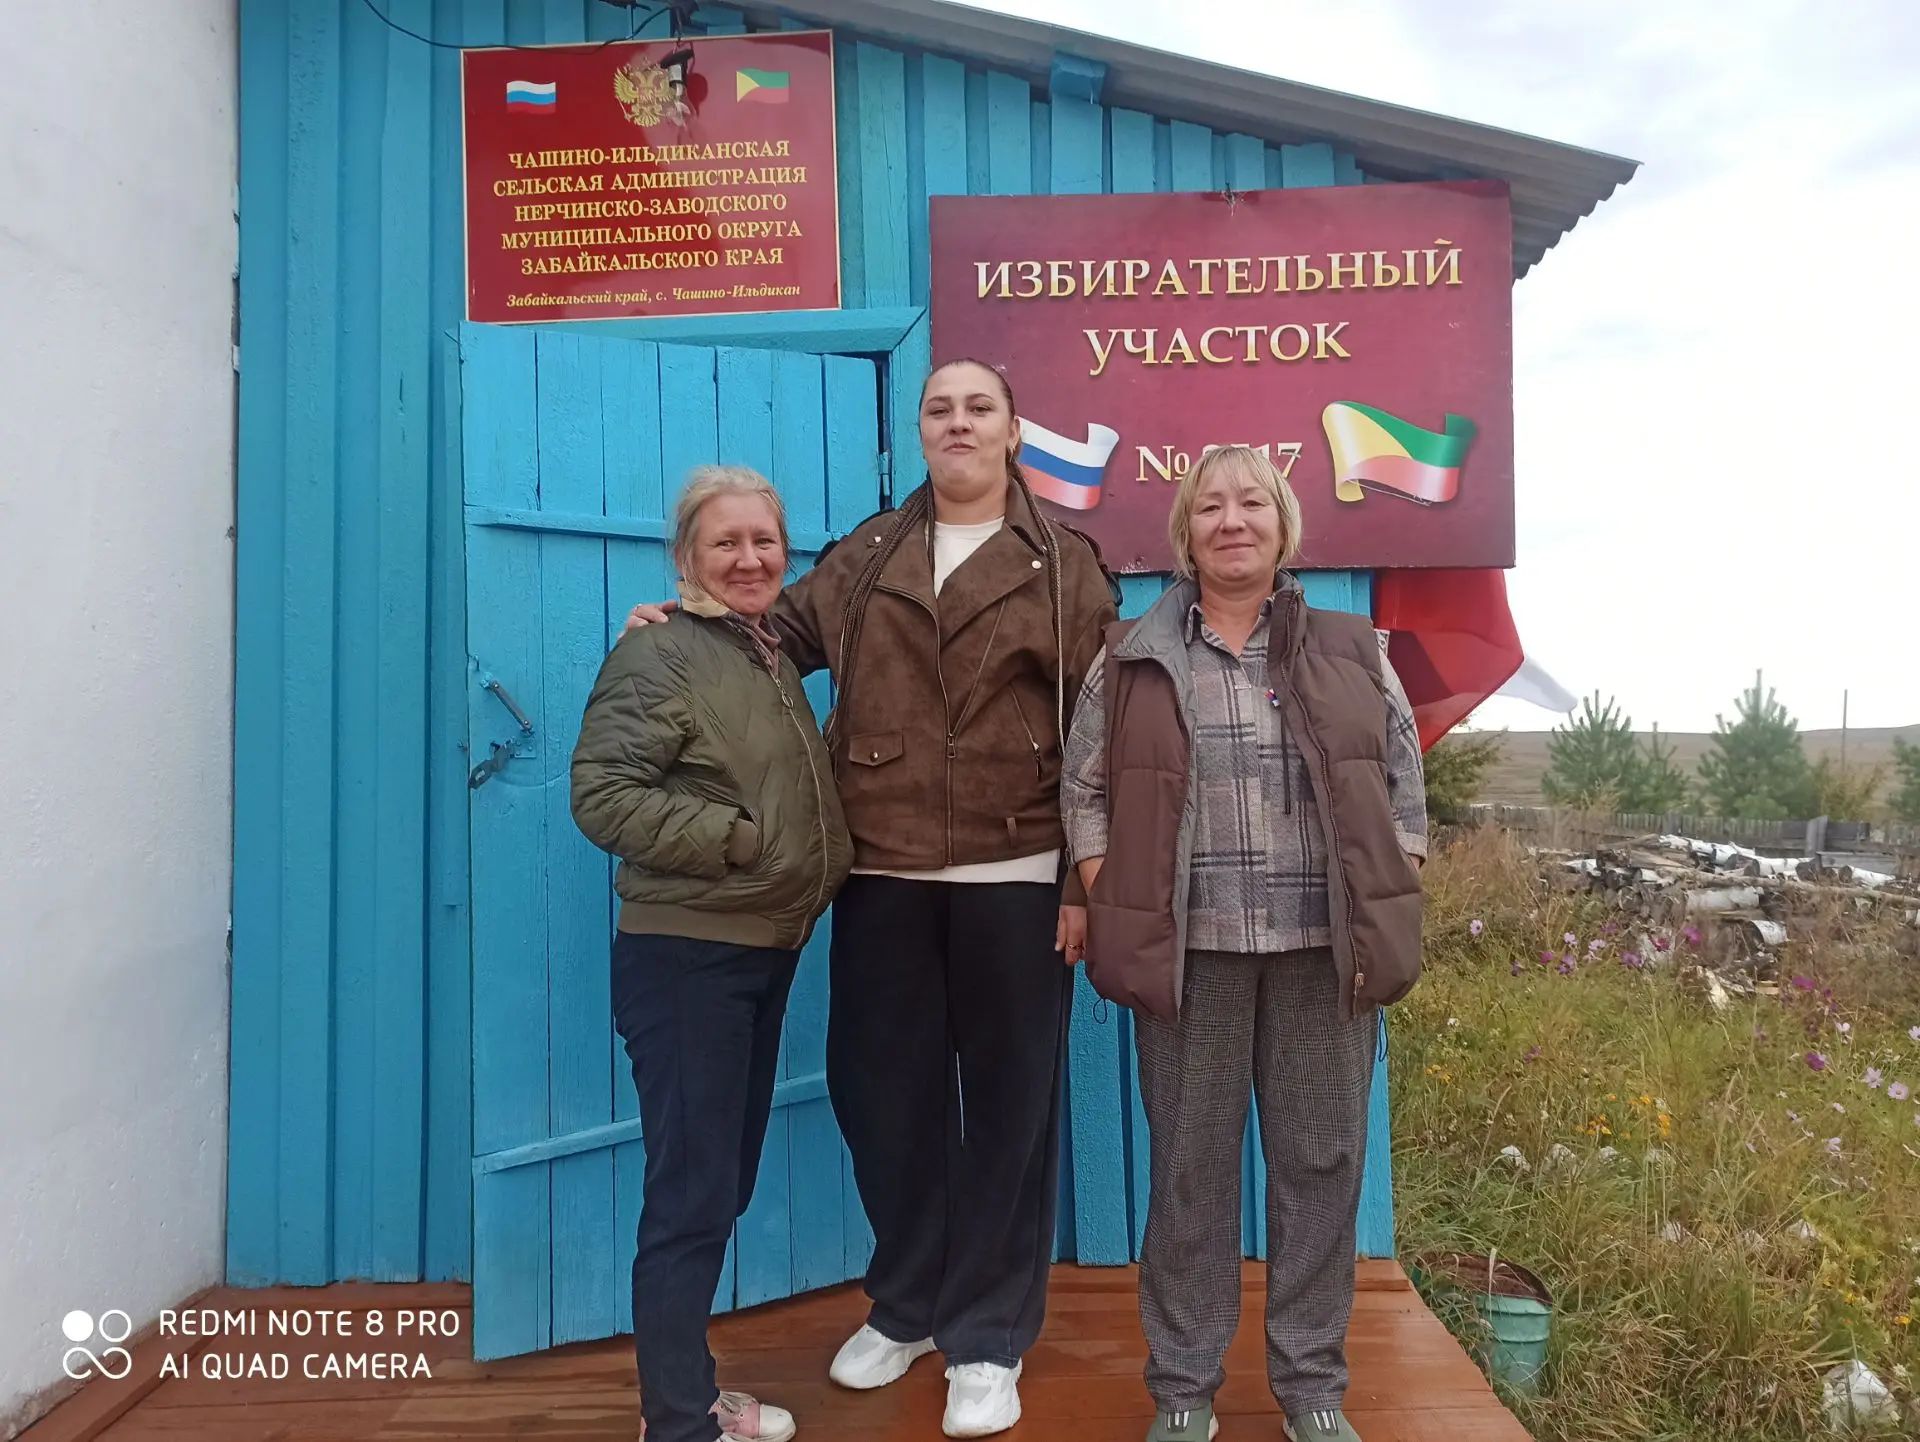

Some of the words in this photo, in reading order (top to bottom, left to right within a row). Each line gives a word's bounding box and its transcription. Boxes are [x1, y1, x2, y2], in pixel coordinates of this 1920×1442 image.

[508, 140, 791, 170] ЧАШИНО-ИЛЬДИКАНСКАЯ
[493, 174, 604, 197] СЕЛЬСКАЯ
[610, 166, 808, 192] АДМИНИСТРАЦИЯ
[514, 193, 788, 222] НЕРЧИНСКО-ЗАВОДСКОГО
[501, 222, 712, 251] МУНИЦИПАЛЬНОГО
[717, 219, 803, 240] ОКРУГА
[521, 249, 719, 275] ЗАБАЙКАЛЬСКОГО
[725, 248, 784, 266] КРАЯ
[973, 237, 1465, 299] ИЗБИРАТЕЛЬНЫЙ
[506, 290, 612, 308] Забайкальский
[614, 291, 652, 307] край,
[655, 292, 667, 302] с.
[671, 283, 801, 302] Чашино-Ильдикан
[1083, 321, 1351, 376] УЧАСТОК
